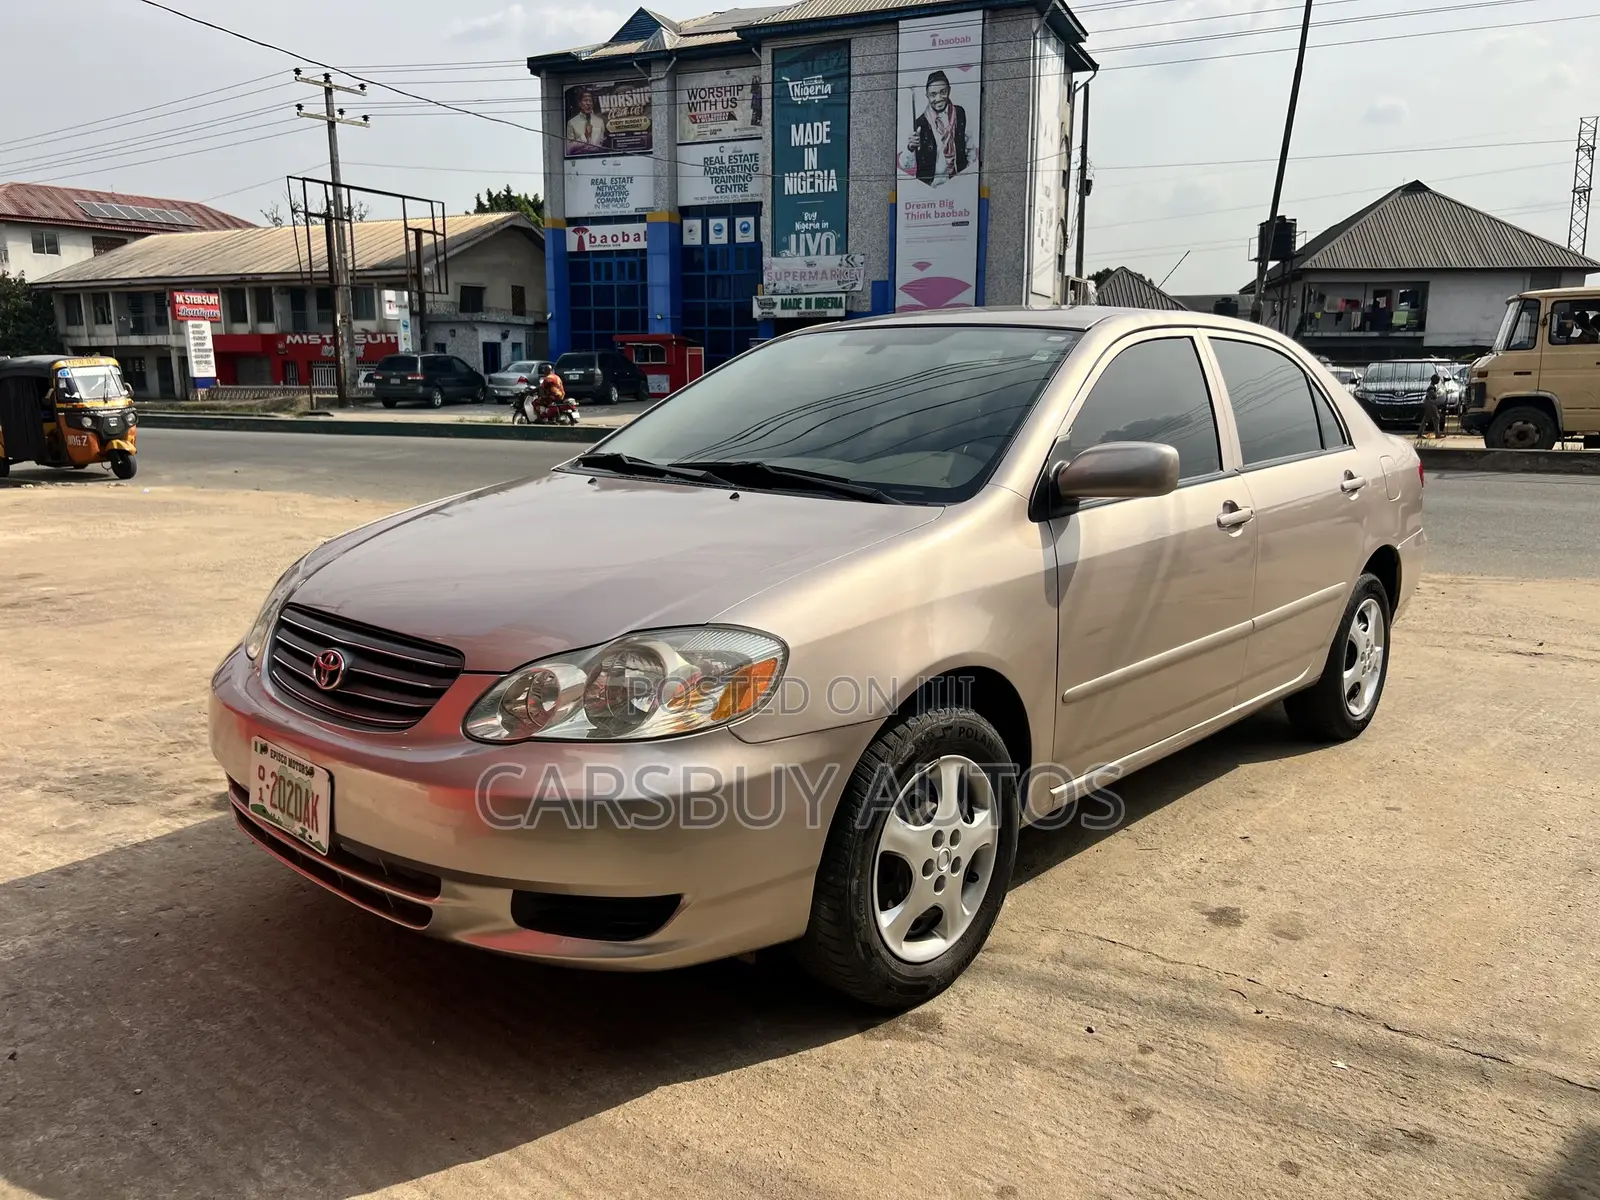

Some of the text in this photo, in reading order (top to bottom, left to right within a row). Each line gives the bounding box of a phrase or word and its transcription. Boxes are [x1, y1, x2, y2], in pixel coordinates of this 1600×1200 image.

[938, 35, 971, 46] baobab
[687, 85, 744, 100] WORSHIP
[793, 83, 832, 100] Nigeria
[688, 97, 738, 112] WITH US
[791, 120, 831, 147] MADE
[703, 153, 760, 167] REAL ESTATE
[804, 147, 818, 170] IN
[703, 163, 760, 176] MARKETING
[590, 176, 634, 186] REAL ESTATE
[709, 173, 754, 185] TRAINING
[784, 169, 838, 195] NIGERIA
[594, 190, 630, 198] MARKETING
[714, 182, 749, 194] CENTRE
[905, 200, 954, 210] Dream Big
[905, 208, 970, 220] Think baobab
[795, 219, 829, 233] Nigeria in
[766, 267, 864, 282] SUPERMARKET
[780, 298, 803, 310] MADE
[804, 297, 813, 310] IN
[814, 296, 844, 309] NIGERIA
[288, 757, 309, 776] MOTORS
